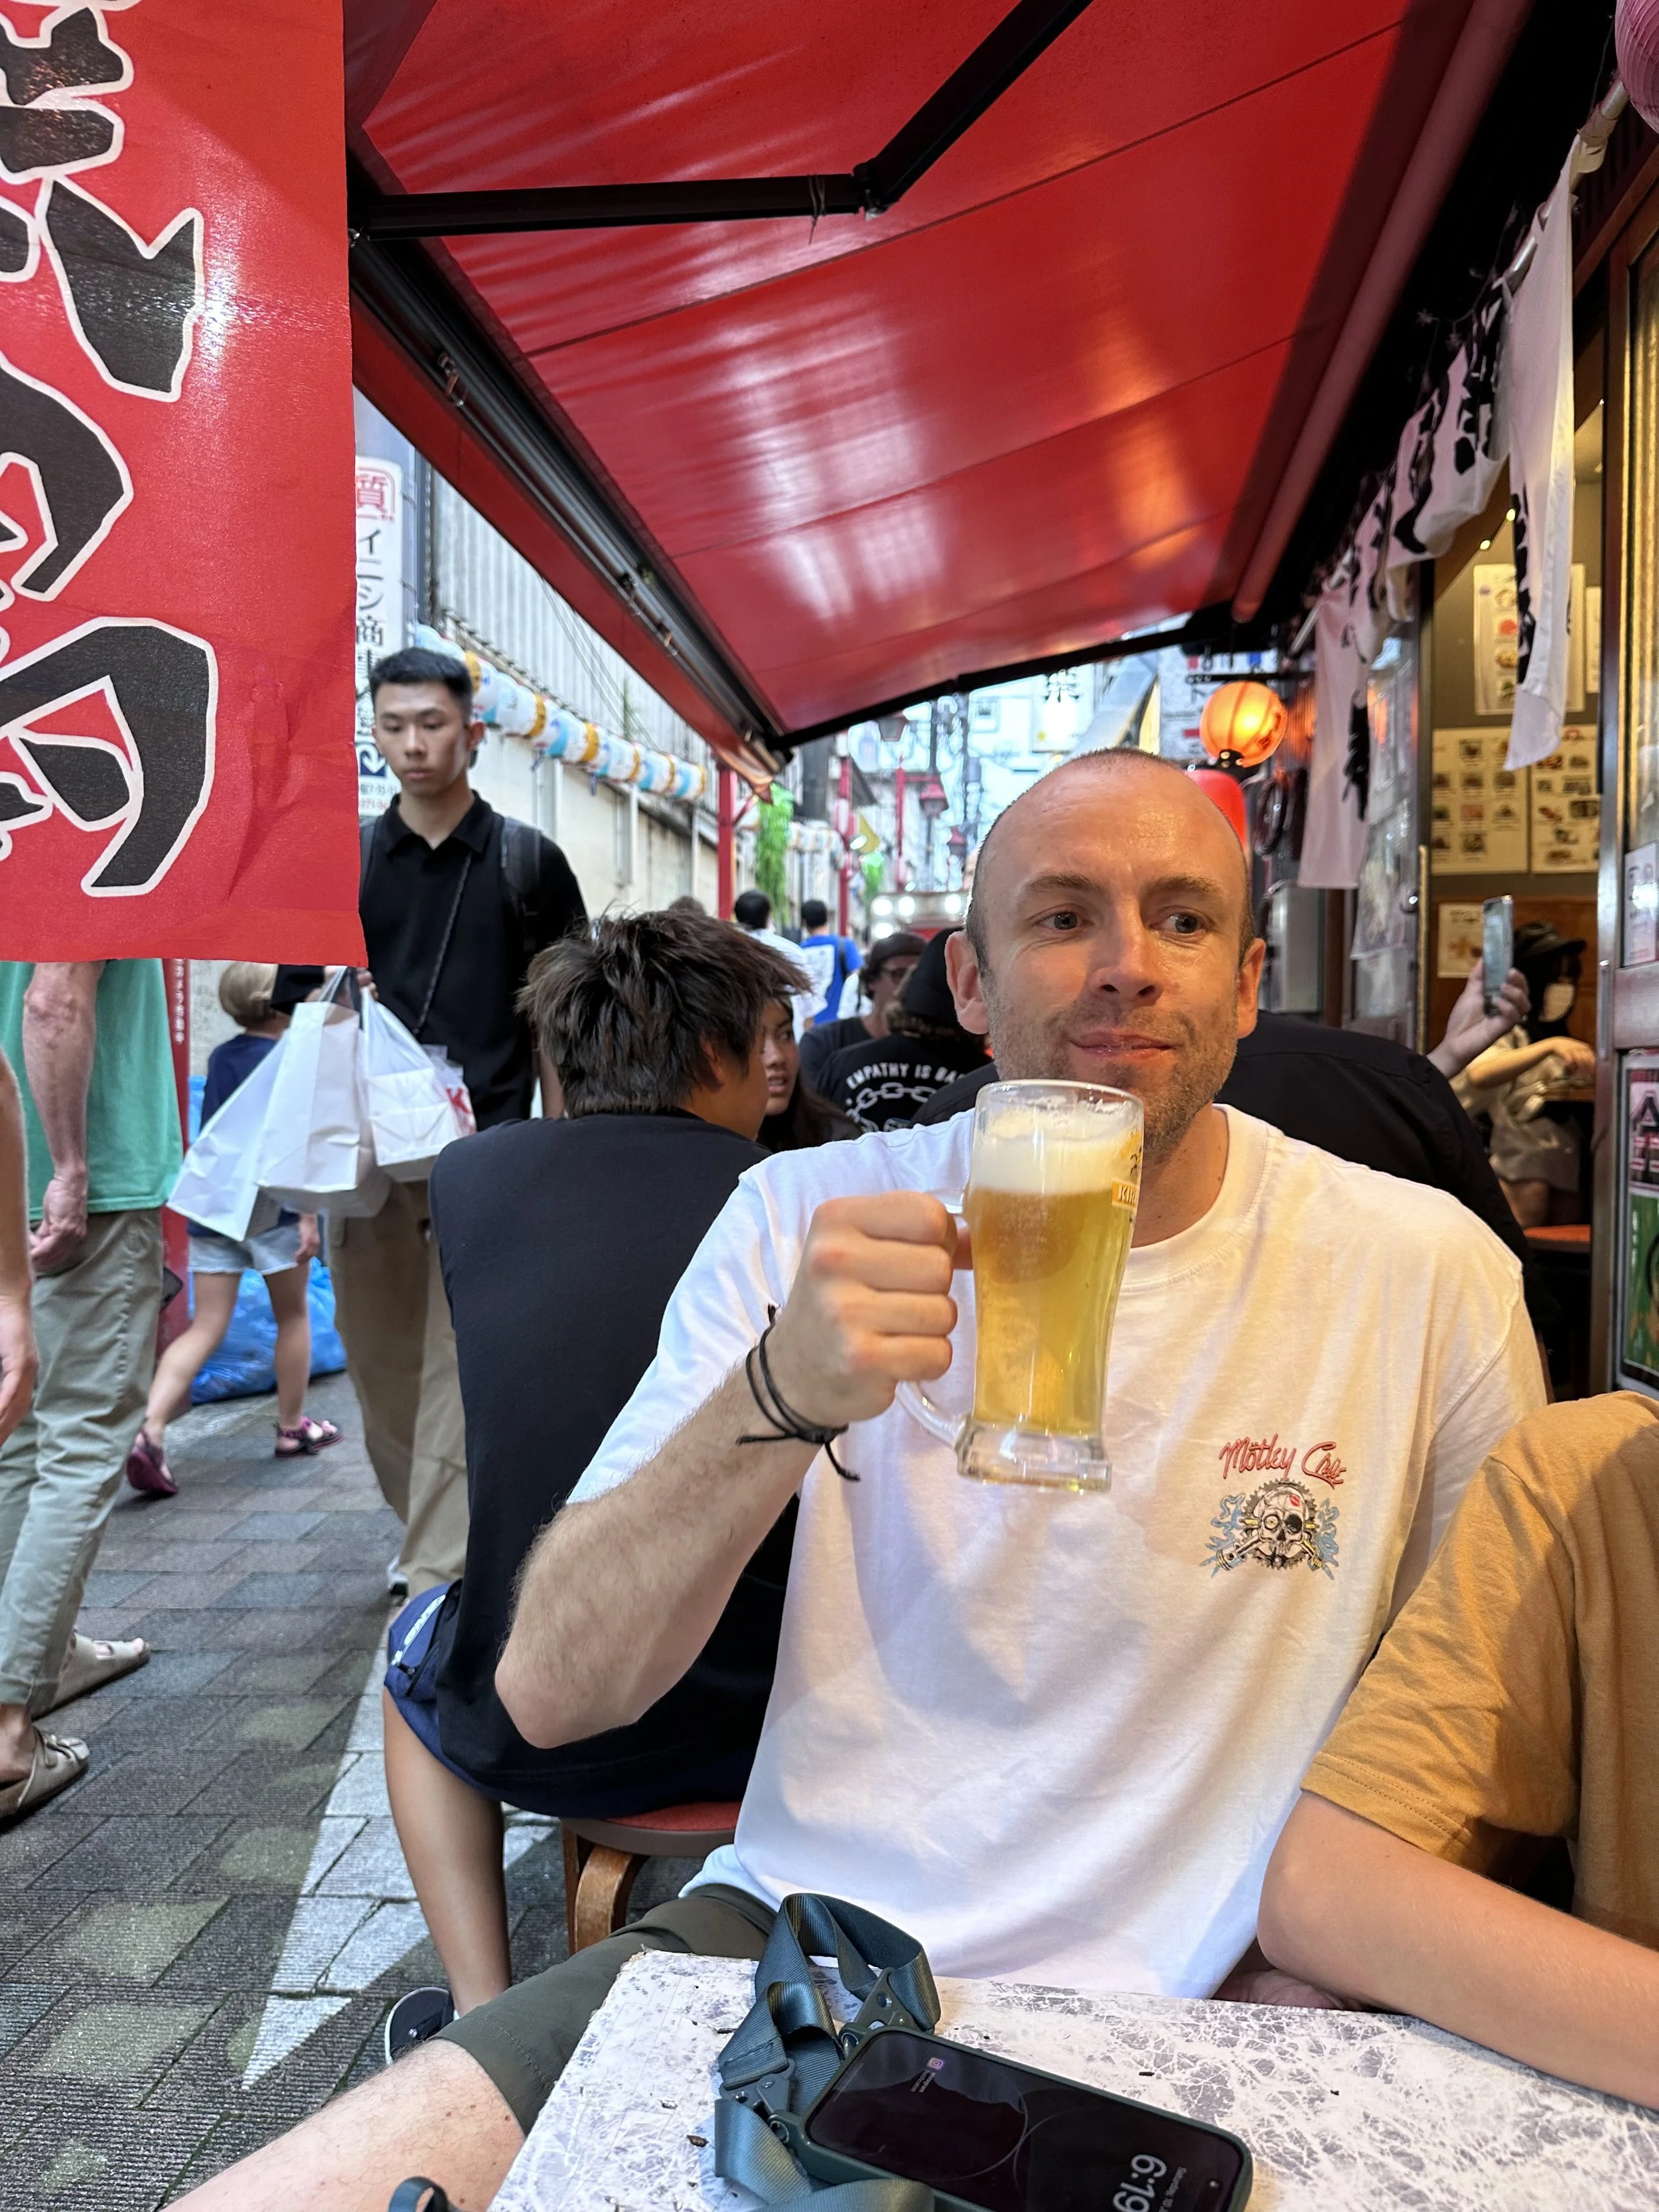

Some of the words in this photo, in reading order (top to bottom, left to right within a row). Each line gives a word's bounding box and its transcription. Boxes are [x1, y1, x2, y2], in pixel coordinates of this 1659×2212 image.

[846, 1062, 909, 1089] EMPATHY
[914, 1064, 932, 1080] IS
[1218, 1434, 1297, 1480] Mötley
[1113, 2154, 1167, 2212] 6:19
